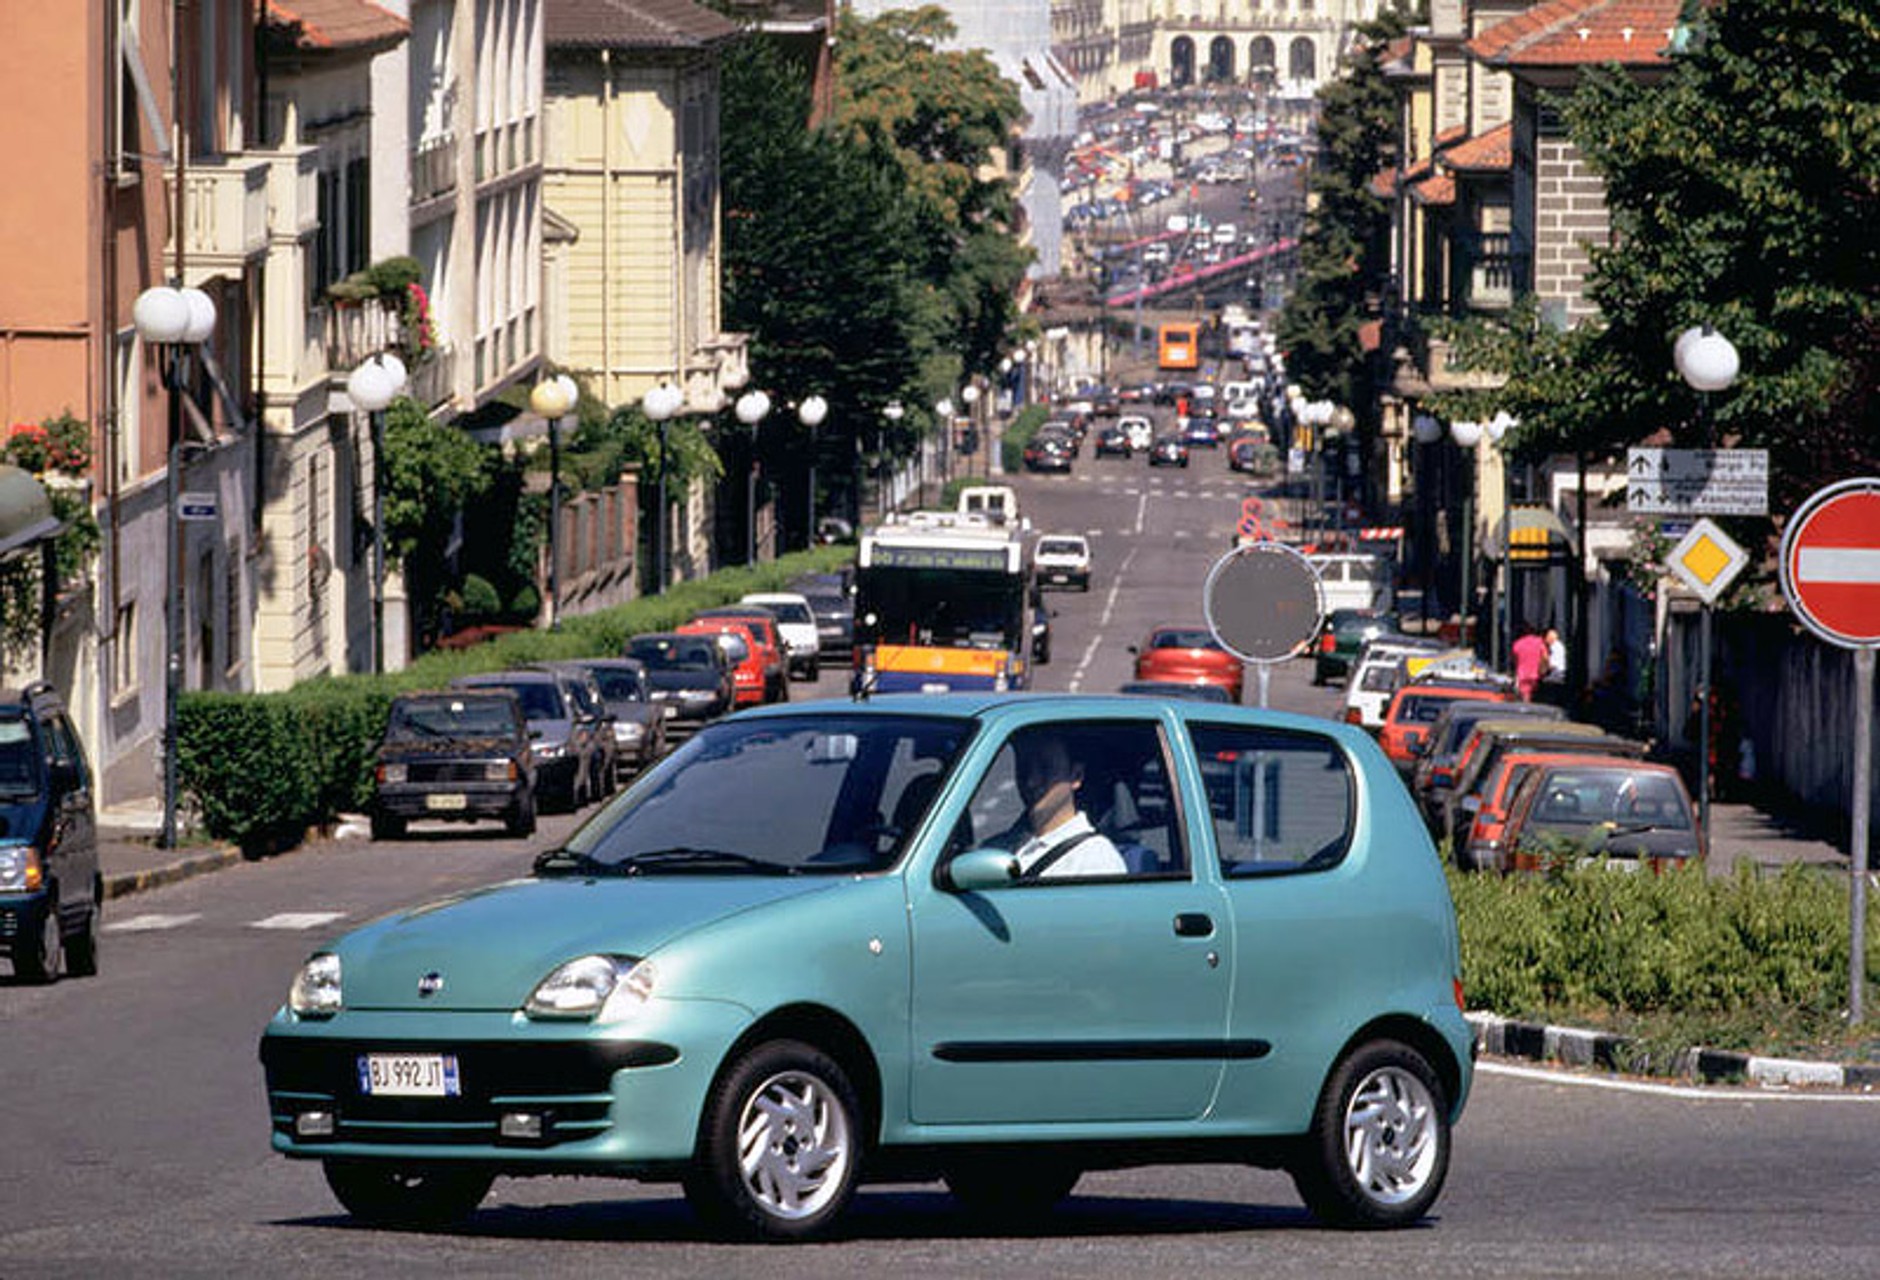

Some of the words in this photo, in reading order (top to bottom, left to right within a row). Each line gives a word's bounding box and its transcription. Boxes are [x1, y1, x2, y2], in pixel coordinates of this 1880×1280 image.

[371, 1061, 388, 1087] BJ
[393, 1061, 421, 1087] 992
[427, 1061, 441, 1087] JT
